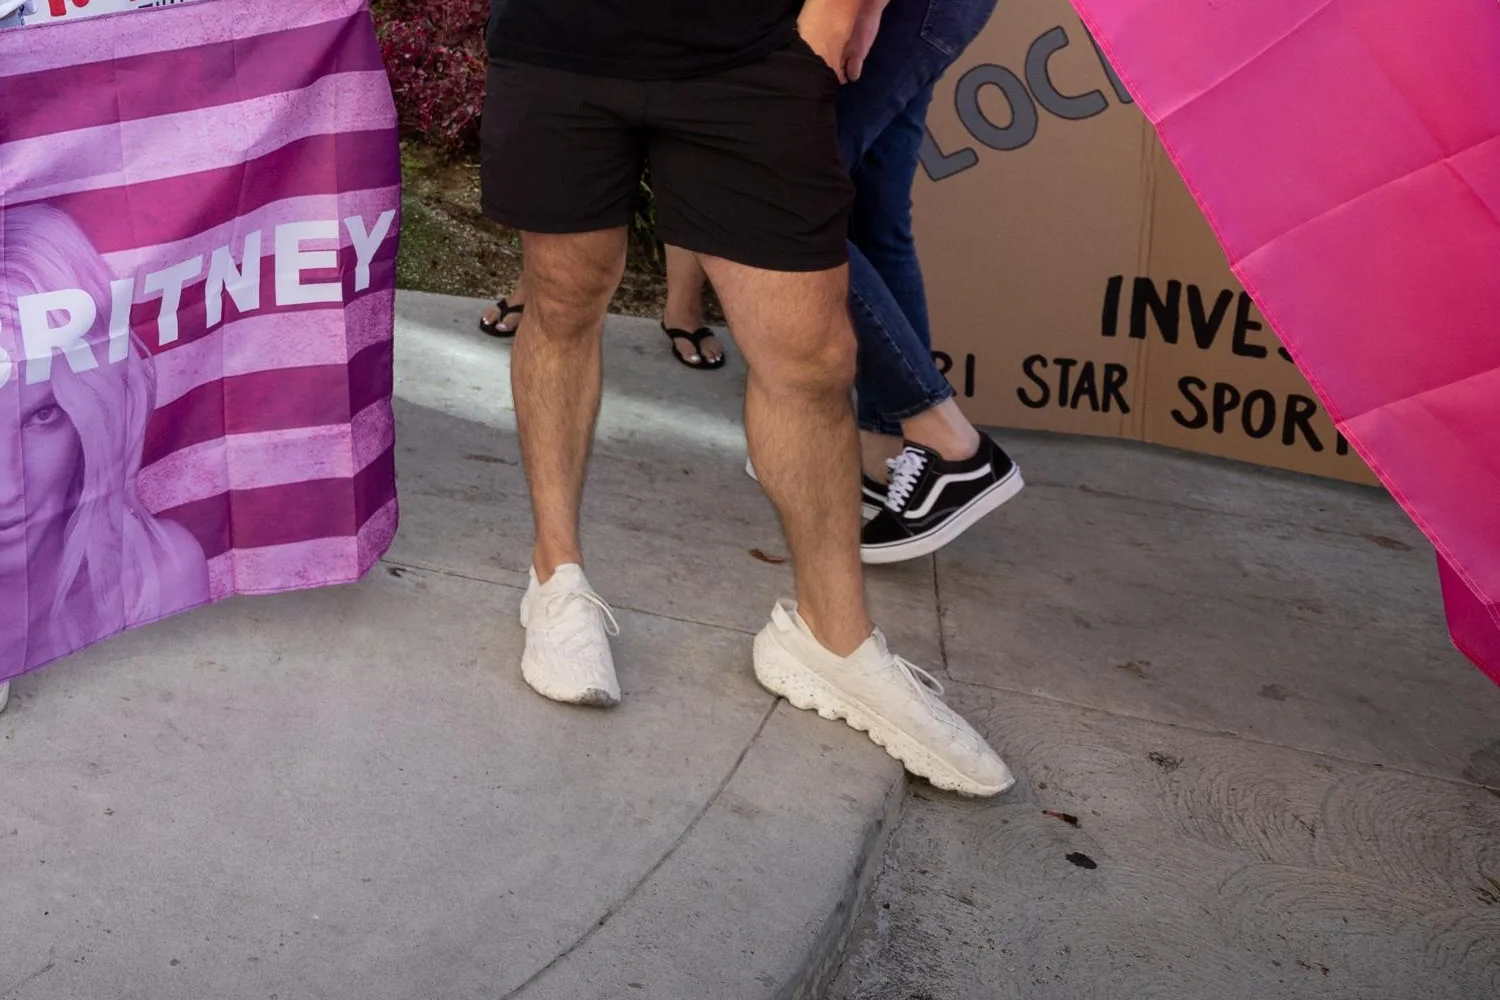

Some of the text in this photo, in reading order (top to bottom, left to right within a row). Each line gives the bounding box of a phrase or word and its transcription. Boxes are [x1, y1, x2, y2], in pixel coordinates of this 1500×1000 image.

[917, 21, 1134, 181] LOC
[1102, 275, 1300, 363] INVE
[1017, 354, 1131, 414] STAR
